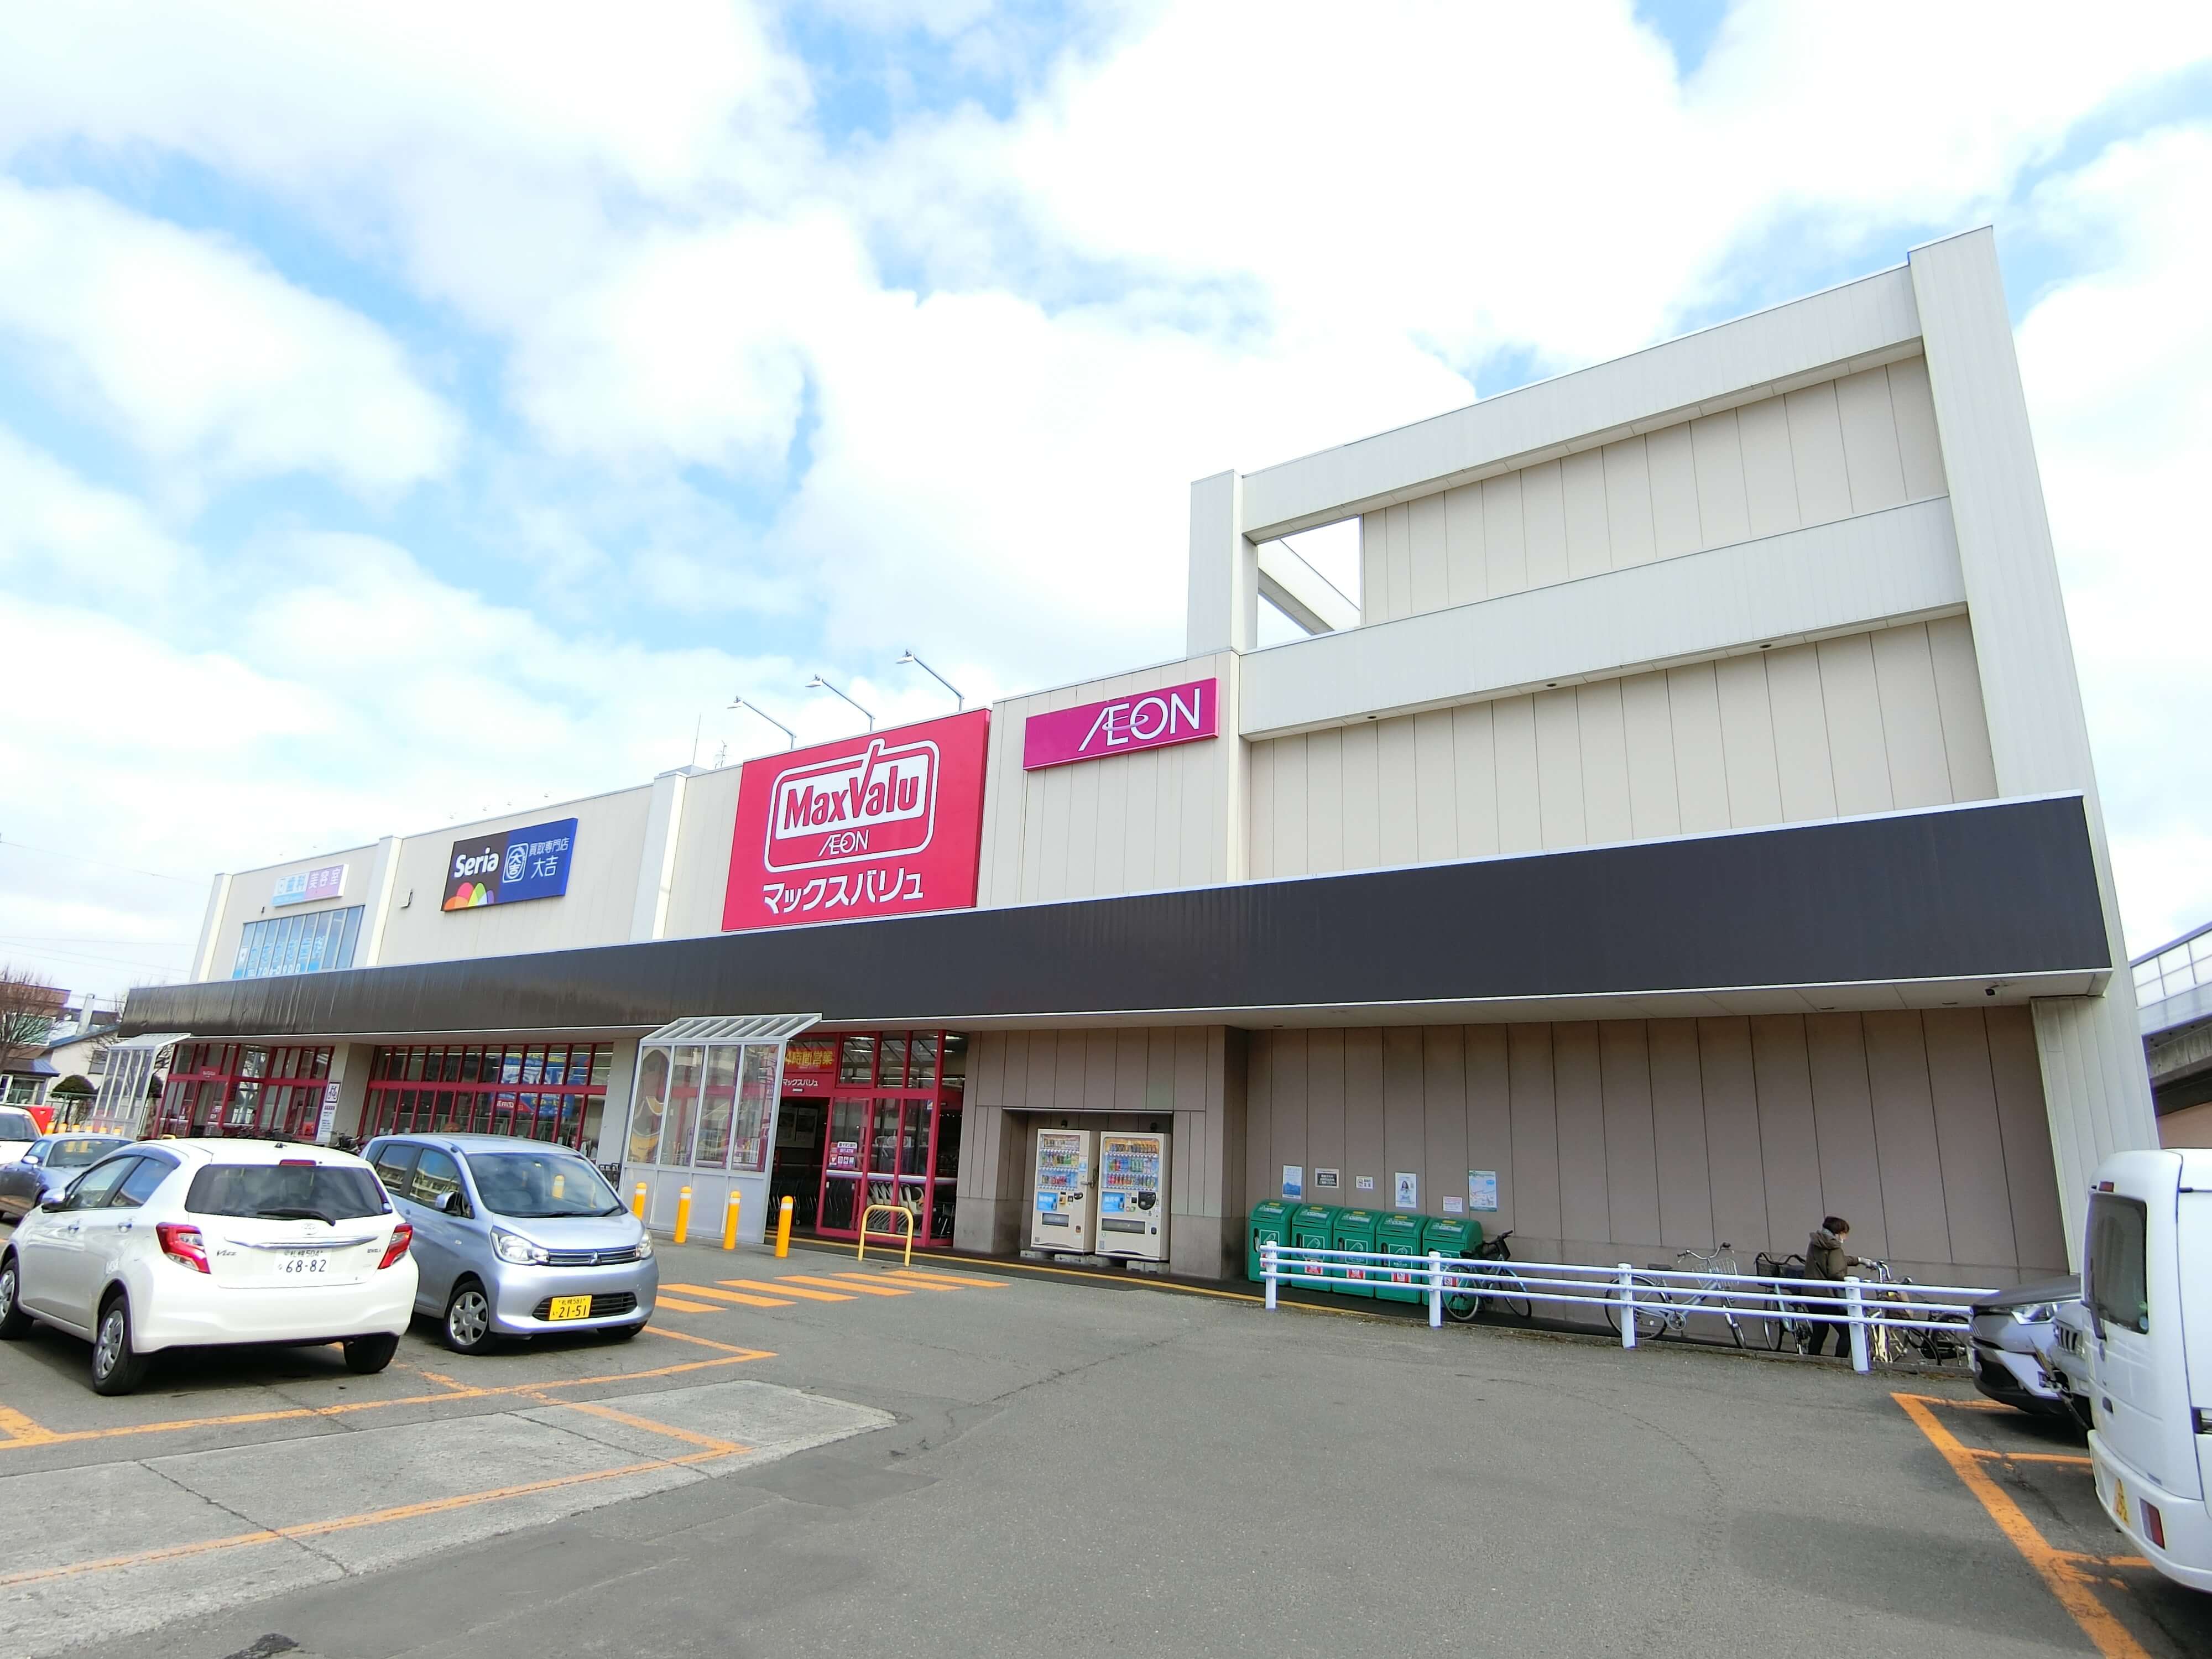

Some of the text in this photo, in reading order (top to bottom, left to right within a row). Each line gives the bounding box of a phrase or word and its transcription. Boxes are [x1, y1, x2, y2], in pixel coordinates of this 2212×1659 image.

[784, 744, 920, 831] MaxValu
[529, 837, 570, 857] 買取専門店
[453, 847, 500, 878] Seria
[530, 855, 559, 879] 大吉
[308, 868, 341, 890] 美容室
[763, 867, 924, 915] マックスバリュ
[286, 1259, 327, 1272] 68-82
[559, 1305, 587, 1318] 21-51
